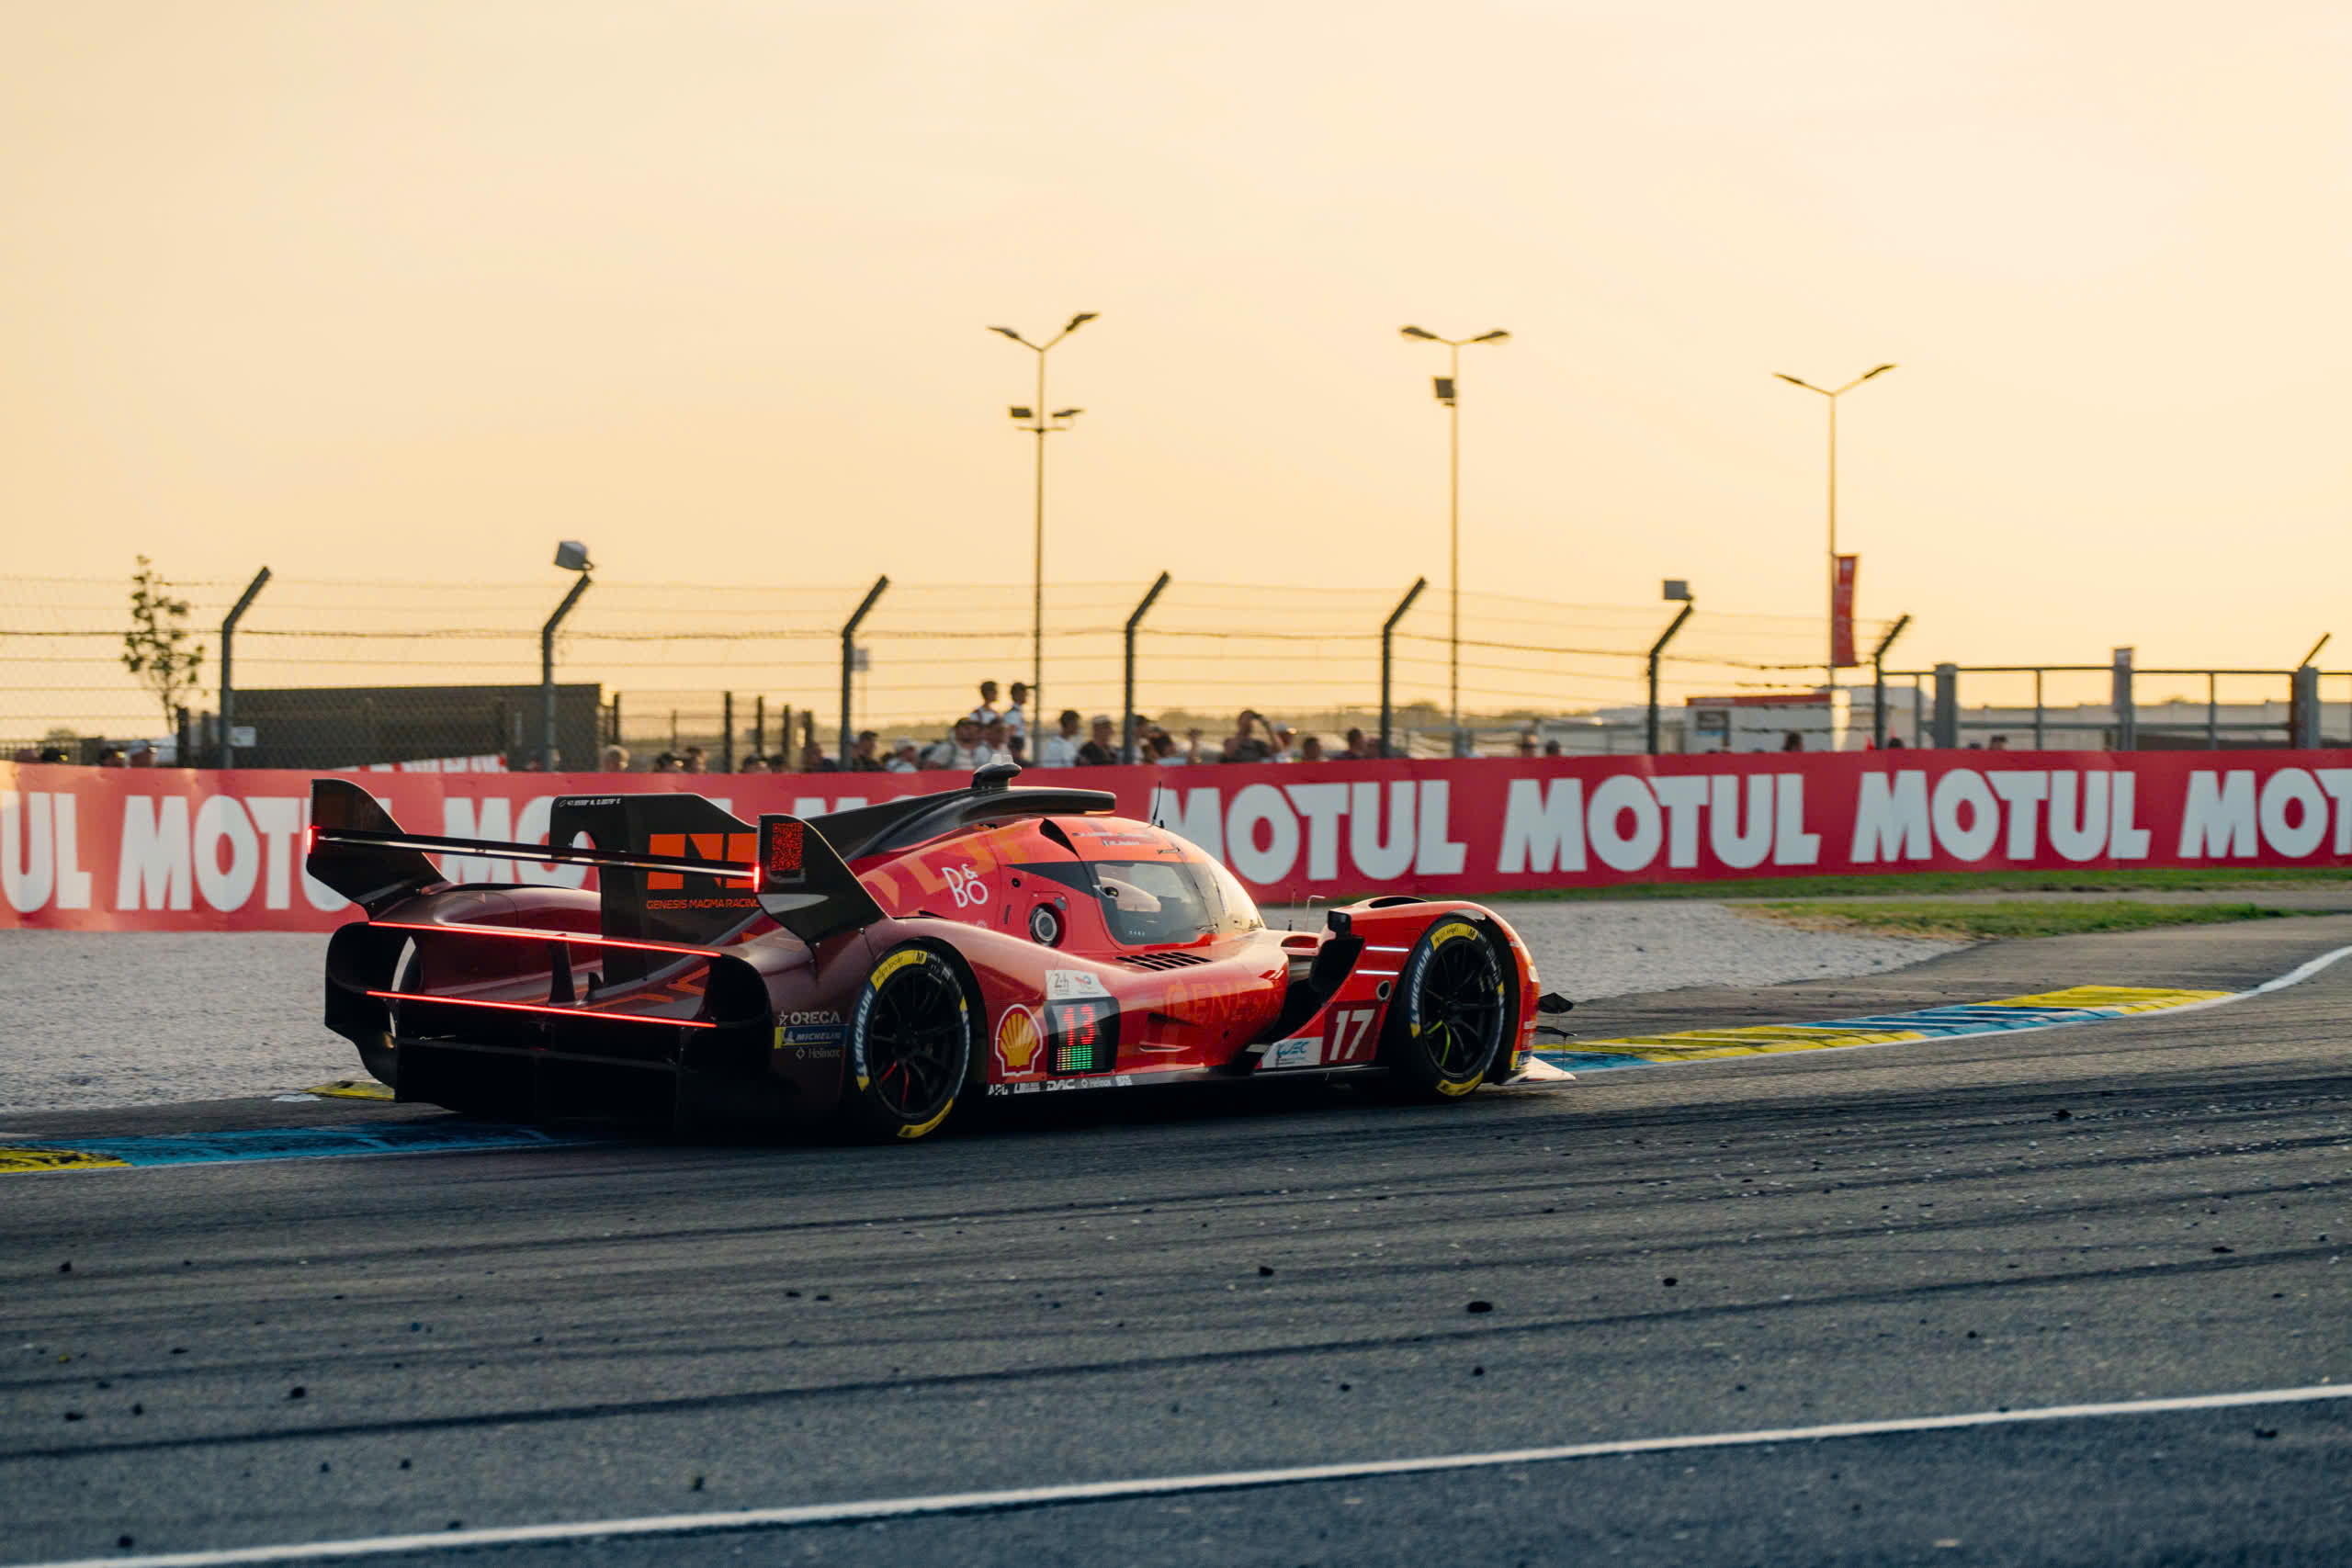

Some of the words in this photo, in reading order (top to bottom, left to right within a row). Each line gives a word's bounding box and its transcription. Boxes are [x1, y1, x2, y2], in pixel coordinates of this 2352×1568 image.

[1148, 781, 1467, 885] MOTUL
[1498, 773, 1821, 873] MOTUL
[1850, 769, 2151, 862] MOTUL
[2178, 768, 2352, 858] MOT
[646, 900, 687, 909] GENESIS
[689, 899, 725, 909] MAGMA
[790, 1011, 841, 1025] ORECA
[855, 990, 874, 1063] MICHELIN
[1063, 1004, 1095, 1045] 13
[1329, 1010, 1375, 1061] 17
